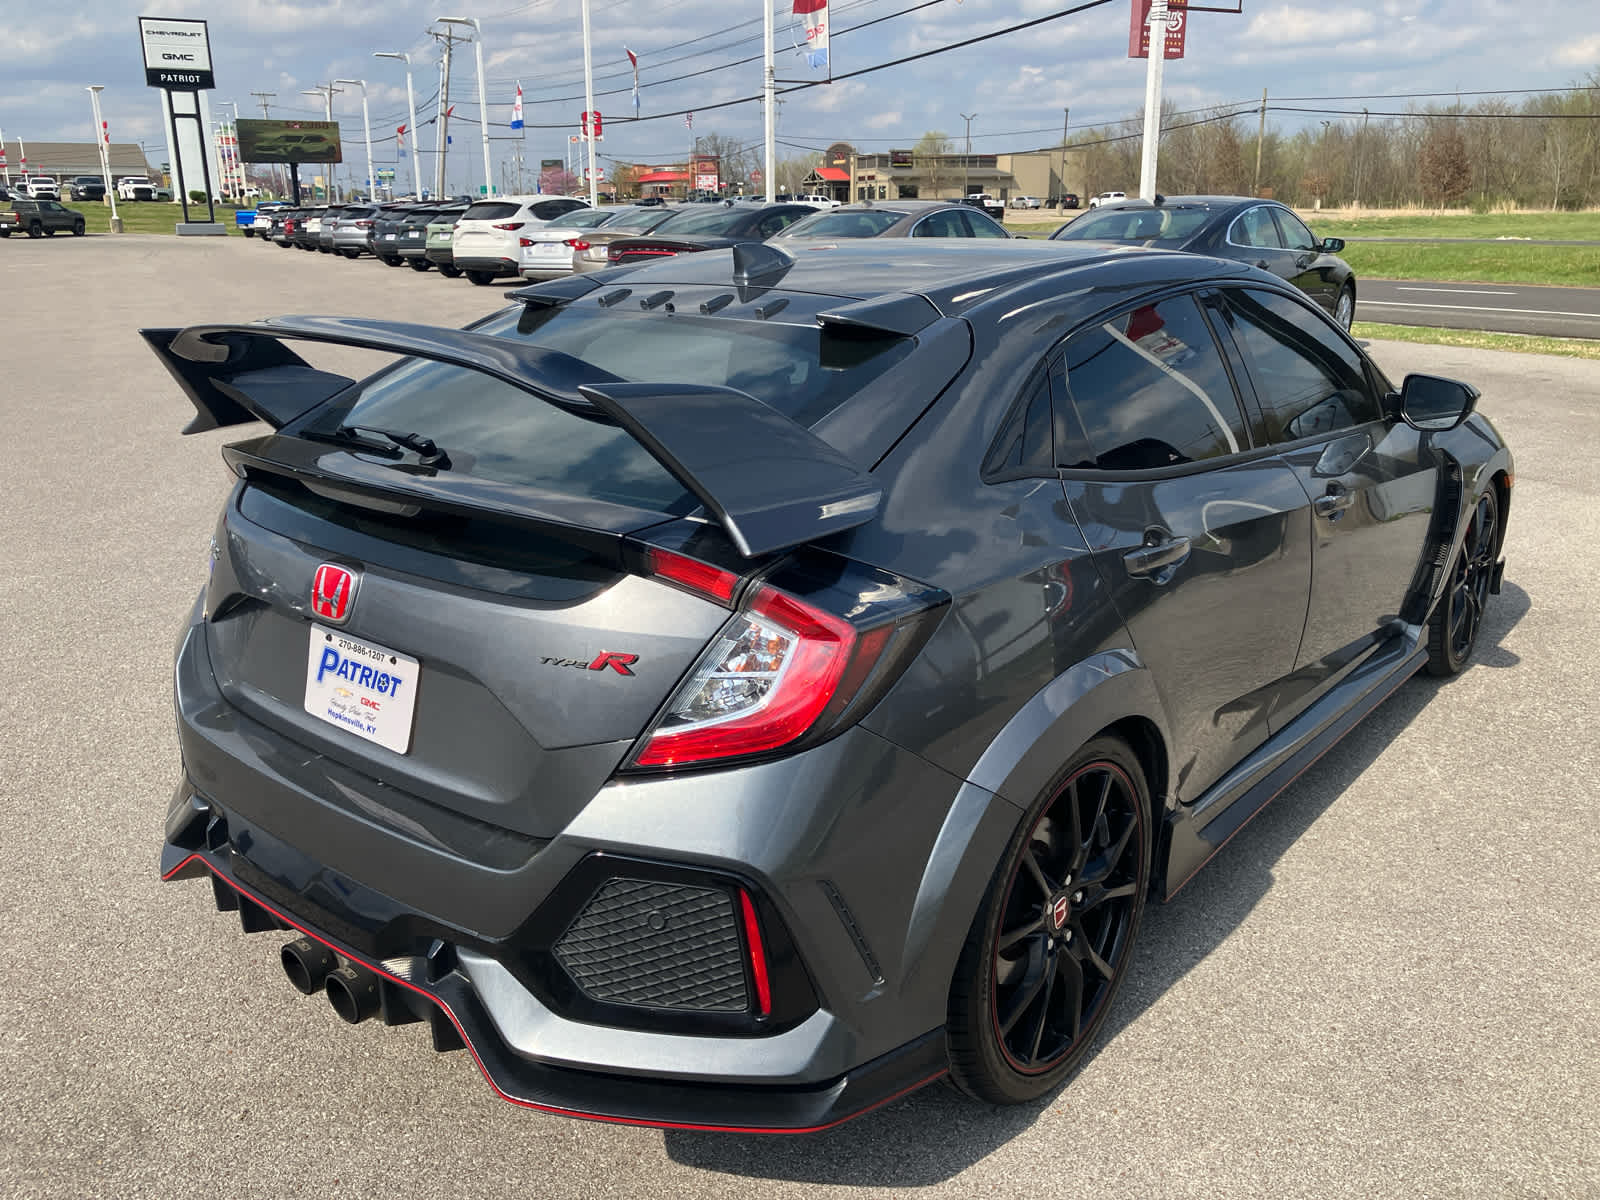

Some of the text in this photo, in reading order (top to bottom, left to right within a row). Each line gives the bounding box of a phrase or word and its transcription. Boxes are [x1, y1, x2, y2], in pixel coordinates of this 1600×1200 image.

[162, 53, 195, 61] GMC
[160, 73, 200, 83] PATRIOT
[338, 639, 385, 662] 270-886-1207
[588, 649, 640, 677] R
[360, 697, 381, 711] GMC
[366, 724, 376, 734] KY
